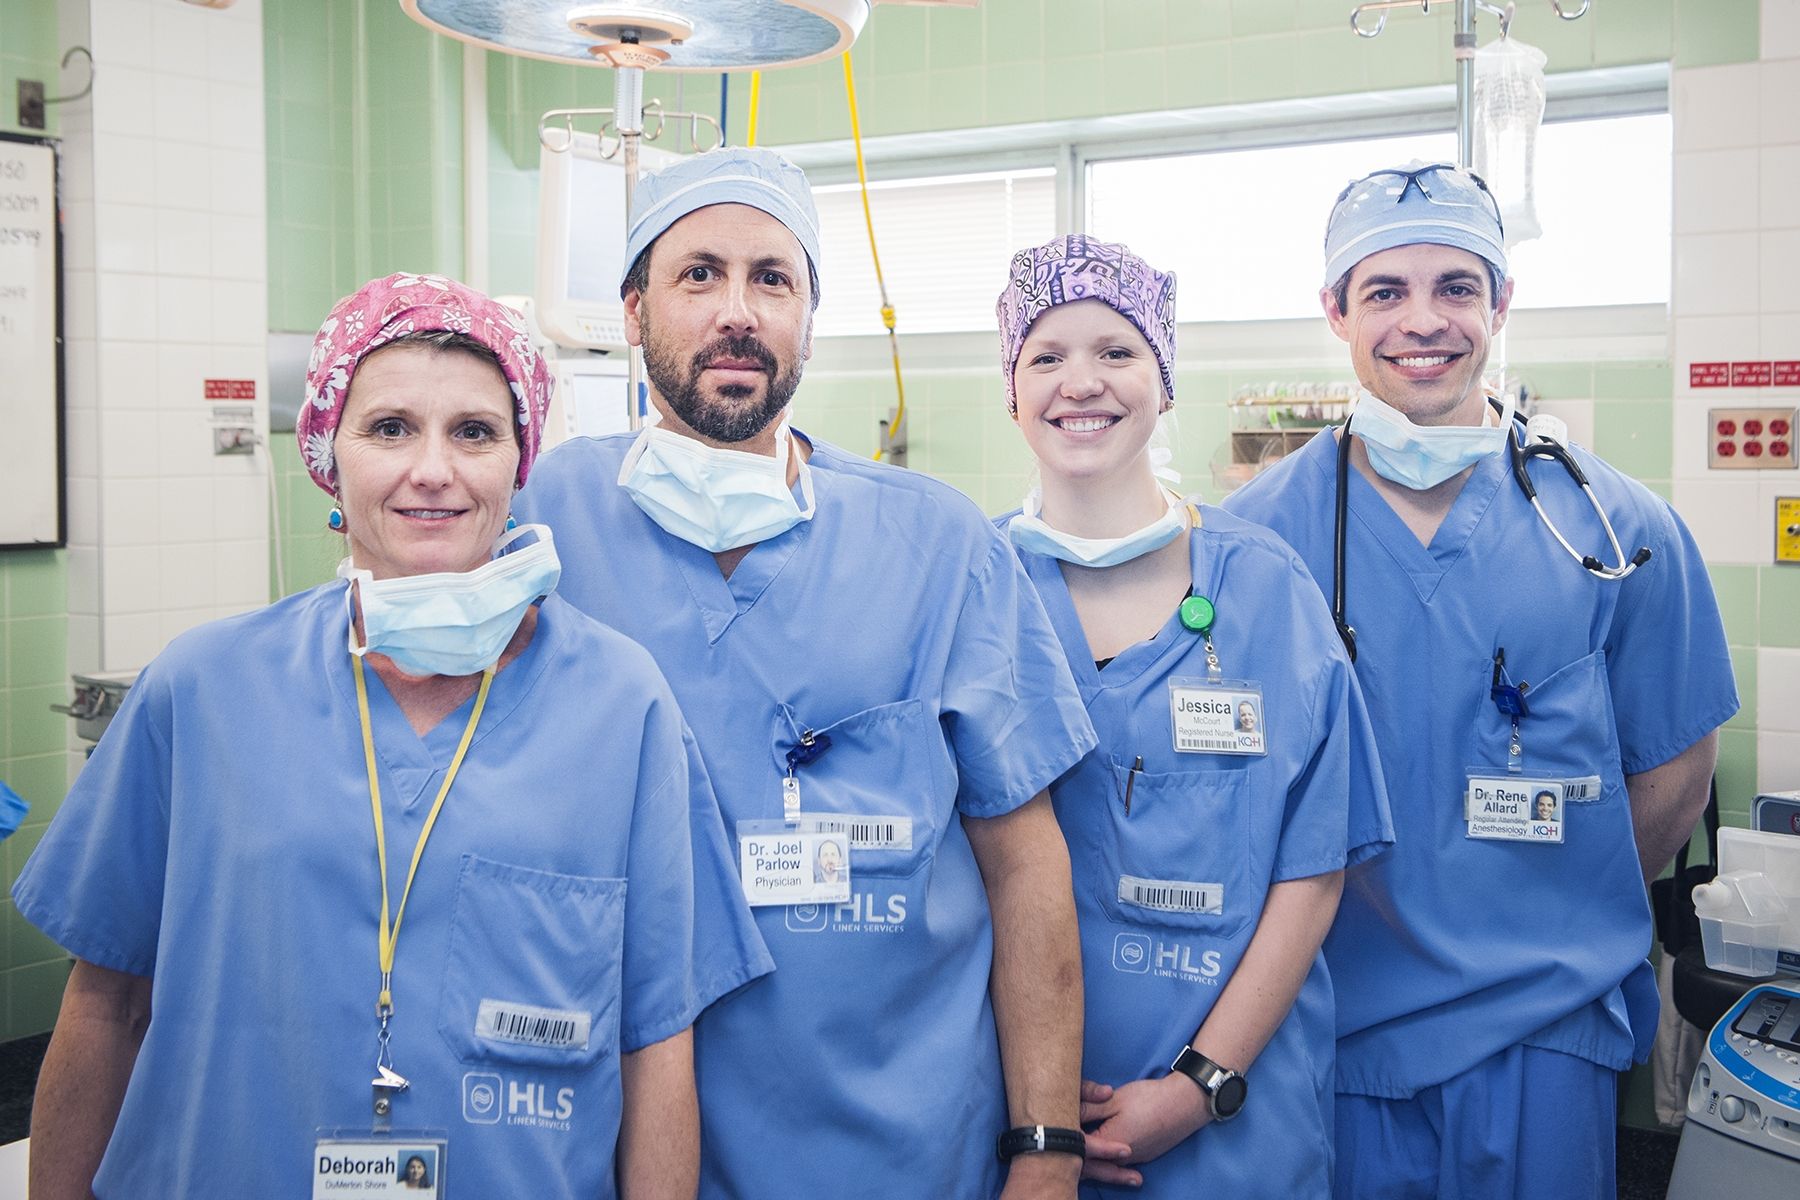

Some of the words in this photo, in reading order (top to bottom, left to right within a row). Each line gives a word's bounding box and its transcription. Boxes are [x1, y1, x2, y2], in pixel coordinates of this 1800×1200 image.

[1178, 697, 1232, 715] Jessica
[1193, 716, 1221, 726] McCourt
[1178, 727, 1213, 737] Registered
[1214, 729, 1234, 738] Nurse
[1475, 788, 1493, 801] Dr.
[1496, 789, 1528, 803] Rene
[1484, 803, 1518, 814] Allard
[1472, 823, 1528, 837] Anesthesiology
[749, 843, 769, 856] Dr.
[774, 840, 802, 856] Joel
[756, 858, 801, 871] Parlow
[755, 876, 801, 889] Physician
[834, 893, 907, 924] HLS
[832, 924, 860, 932] LINEN
[863, 924, 905, 933] SERVICES
[1155, 942, 1221, 977] HLS
[1154, 969, 1178, 979] LINEN
[1179, 973, 1218, 986] SERVICES
[508, 1080, 575, 1120] HLS
[319, 1156, 395, 1175] Deborah
